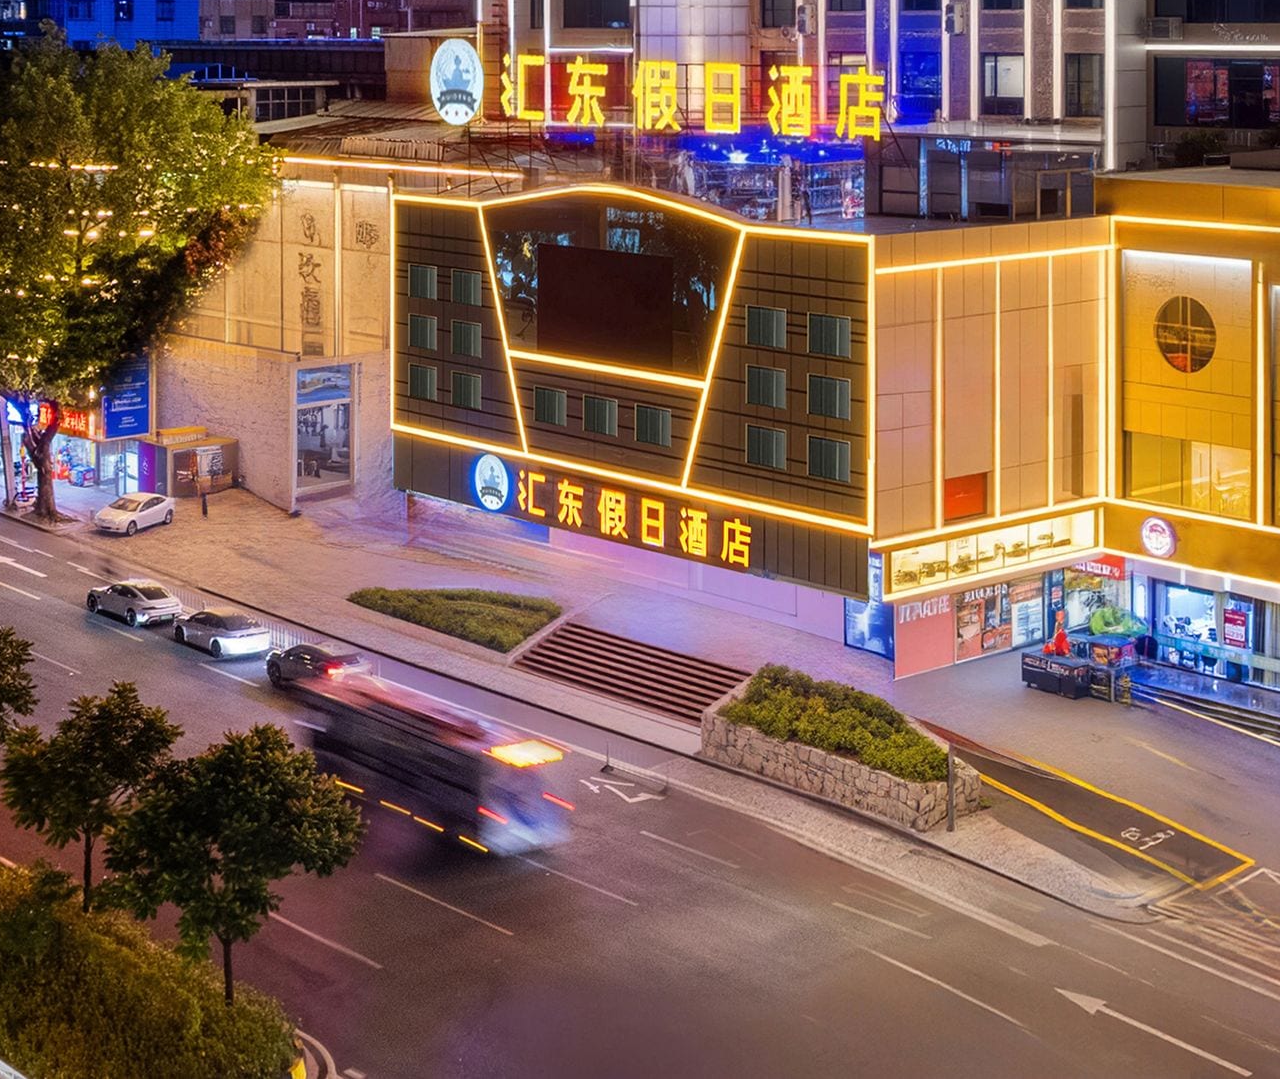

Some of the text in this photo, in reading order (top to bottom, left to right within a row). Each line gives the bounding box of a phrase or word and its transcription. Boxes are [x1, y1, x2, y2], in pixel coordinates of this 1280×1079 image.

[500, 53, 886, 141] 汇东假日酒店
[517, 470, 752, 568] 汇东假日酒店
